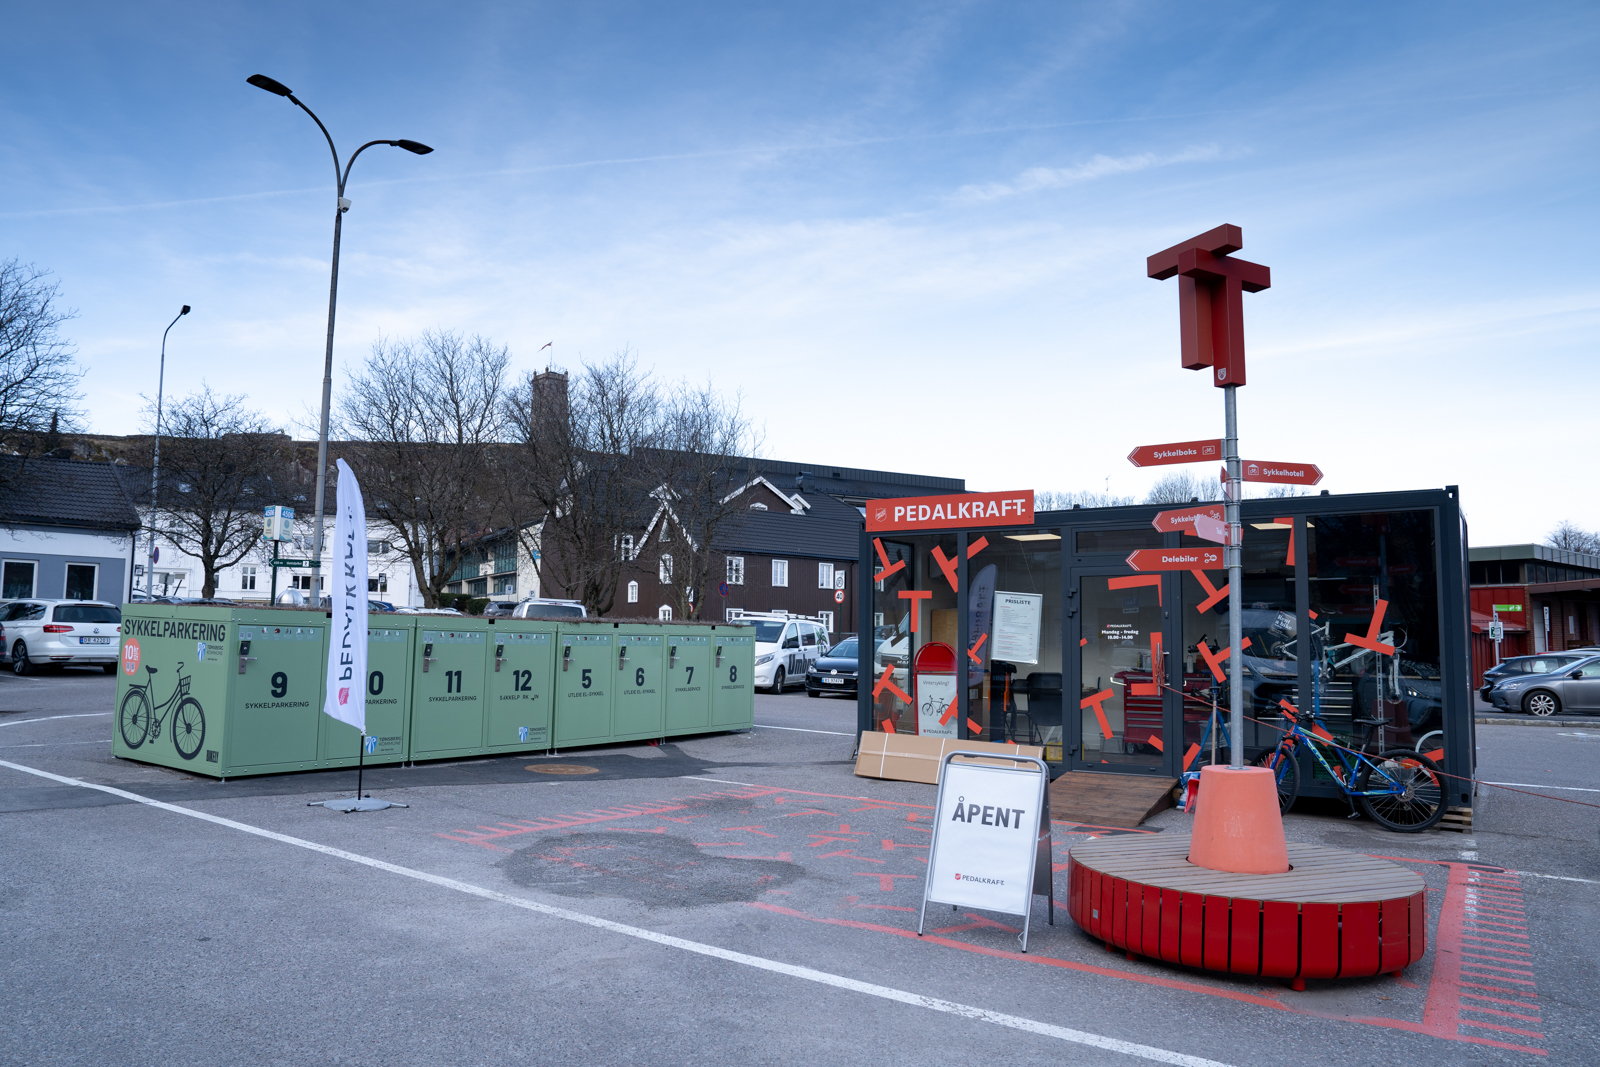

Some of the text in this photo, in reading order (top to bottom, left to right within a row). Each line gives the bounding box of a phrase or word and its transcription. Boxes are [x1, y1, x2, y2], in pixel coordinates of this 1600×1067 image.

[1153, 448, 1197, 459] Sykkelboks
[1263, 467, 1304, 477] Sykkelhotell
[894, 499, 1026, 522] PEDALKRAFT
[1162, 554, 1198, 563] Delebiler
[124, 618, 226, 642] SYKKELPARKERING
[125, 645, 134, 660] 10
[366, 671, 384, 696] 0
[445, 670, 462, 693] 11
[512, 669, 532, 691] 12
[581, 668, 592, 689] 5
[635, 667, 645, 687] 6
[685, 666, 694, 684] 7
[729, 665, 737, 683] 8
[271, 671, 288, 698] 9
[245, 701, 310, 709] SYKKELPARKERING
[951, 795, 1025, 829] ÅPENT
[962, 874, 1005, 886] PEDALKRAFT
